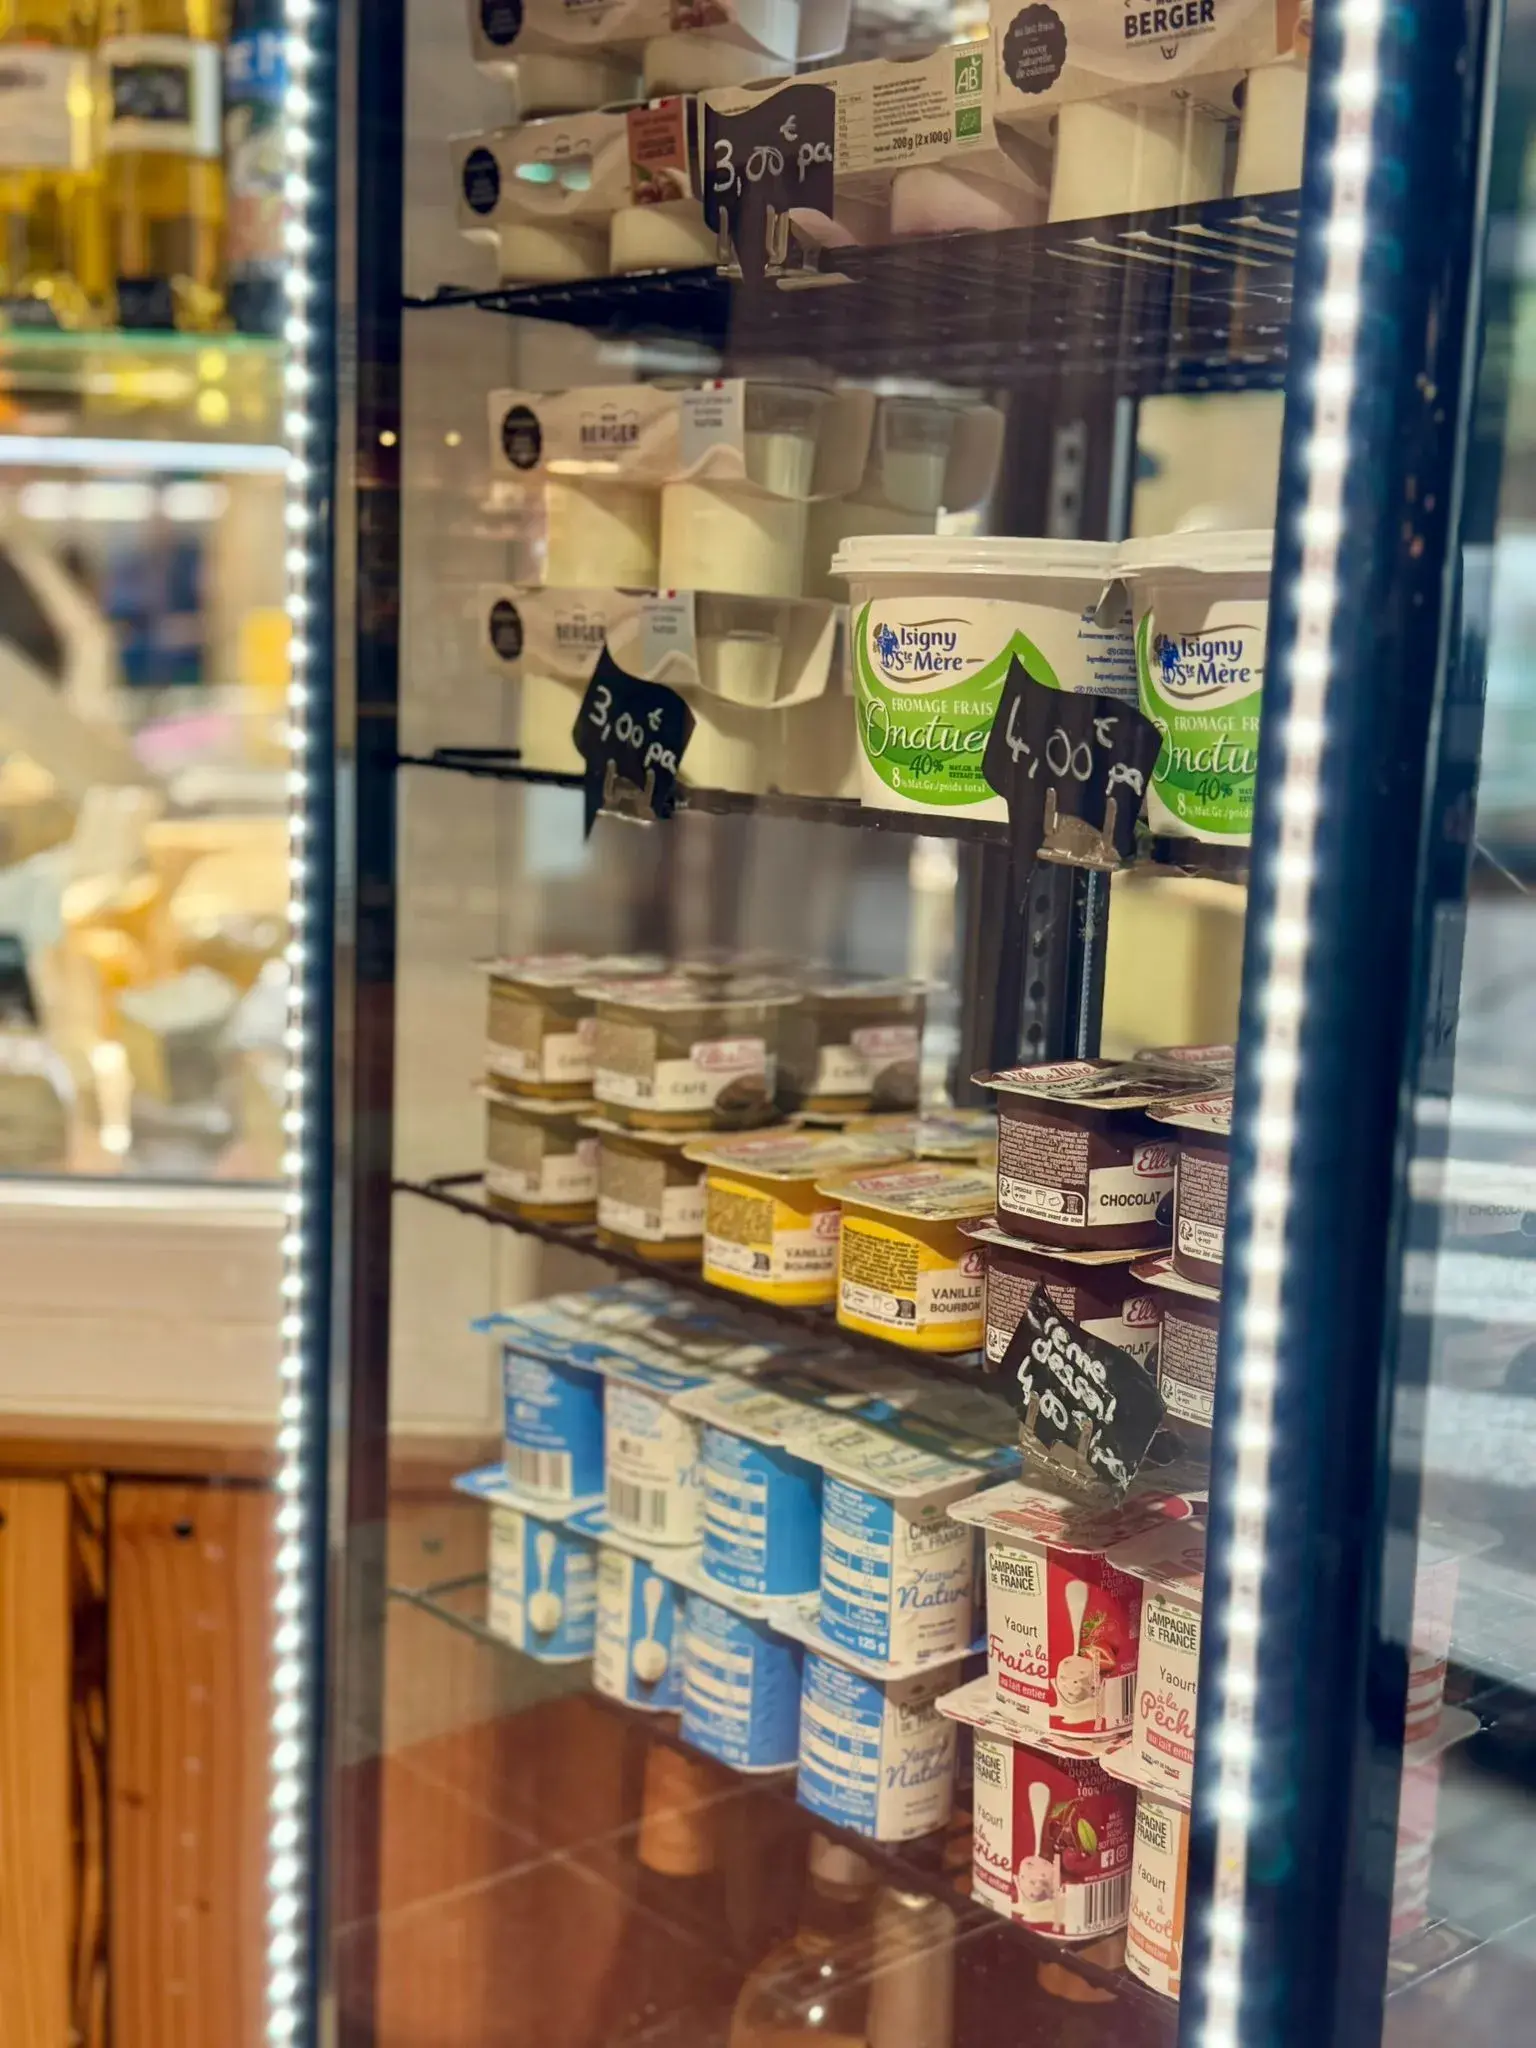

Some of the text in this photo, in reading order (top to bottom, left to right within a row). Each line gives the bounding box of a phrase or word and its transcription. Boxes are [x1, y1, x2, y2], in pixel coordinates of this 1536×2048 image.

[1124, 0, 1215, 39] BERGER
[956, 65, 979, 94] AB
[713, 139, 785, 197] 3,00
[780, 114, 798, 141] €
[901, 628, 957, 651] Isigny
[1181, 637, 1243, 662] Isigny
[895, 651, 963, 671] Ste Mère
[1176, 662, 1251, 686] Ste Mère
[588, 685, 644, 749] 3,00
[647, 707, 664, 731] €
[892, 697, 993, 716] FROMAGE FRAIS
[1174, 715, 1240, 732] FROMAGE
[1006, 695, 1093, 782] 4,00
[909, 754, 944, 779] 40%
[1137, 1147, 1169, 1172] Elle
[1100, 1187, 1161, 1207] CHOCOLAT
[785, 1246, 834, 1258] VANILLE
[931, 1285, 982, 1299] VANILLE
[930, 1301, 981, 1313] BOURBON
[989, 1552, 1034, 1578] CAMPAGNE
[1000, 1574, 1035, 1591] FRANCE
[1004, 1614, 1038, 1639] Yaourt
[1147, 1603, 1197, 1638] CAMPAGNE
[858, 1634, 877, 1652] 125
[1025, 1642, 1033, 1658] à
[1158, 1627, 1197, 1651] FRANCE
[989, 1633, 1049, 1680] Fraise
[1159, 1664, 1197, 1695] Yaourt
[1141, 1689, 1195, 1739] Pêch
[1077, 1786, 1100, 1796] 100%
[1138, 1860, 1166, 1894] Yaourt
